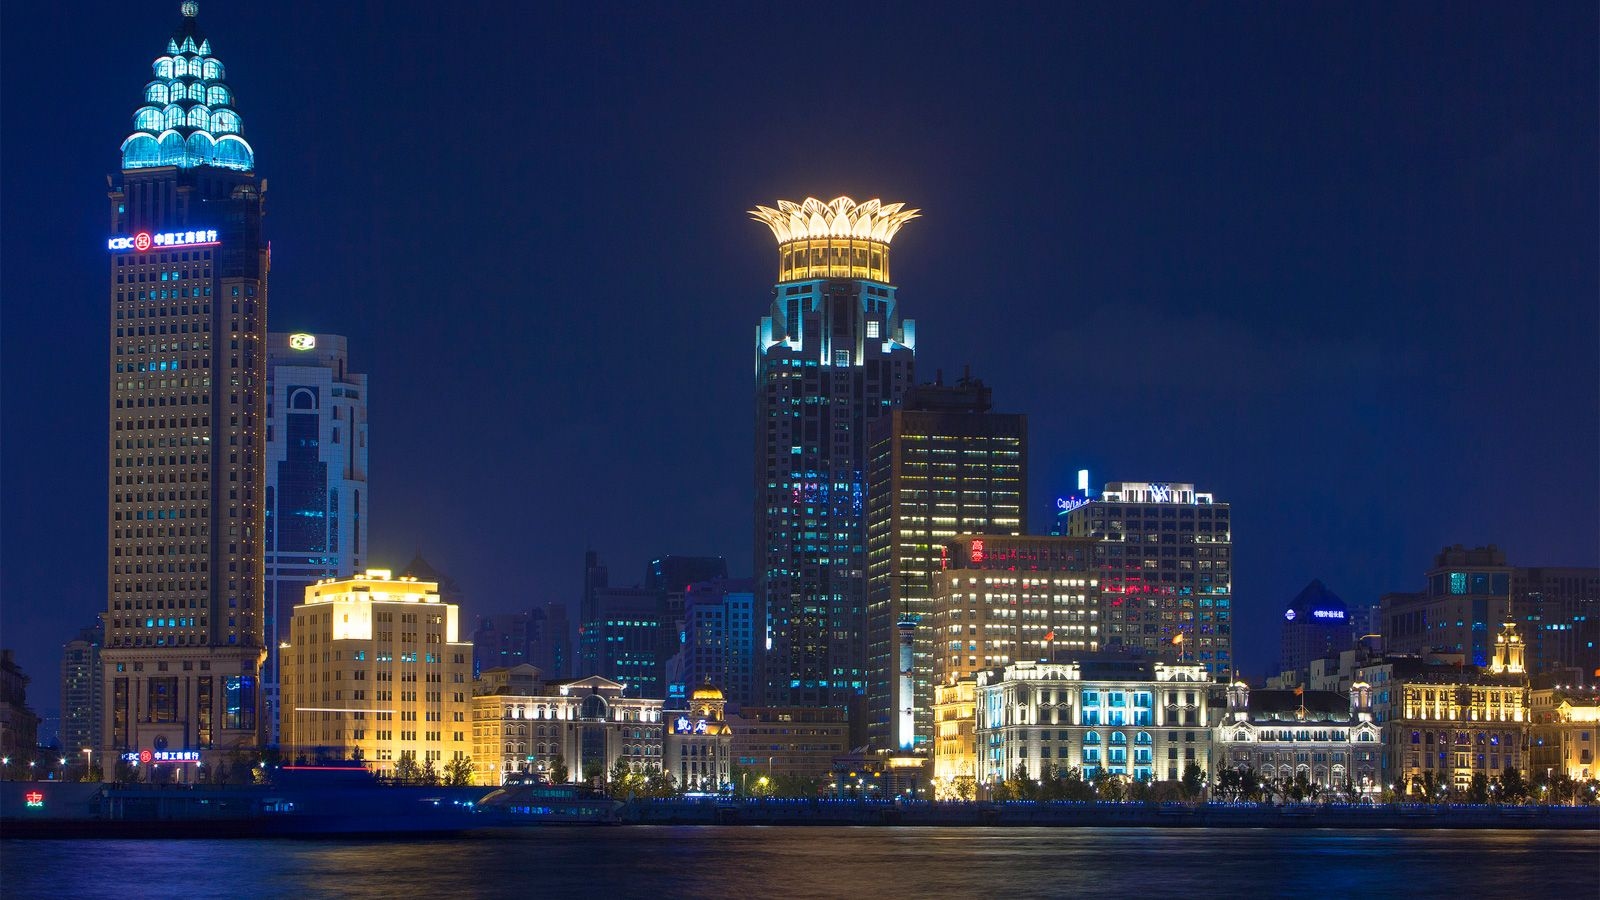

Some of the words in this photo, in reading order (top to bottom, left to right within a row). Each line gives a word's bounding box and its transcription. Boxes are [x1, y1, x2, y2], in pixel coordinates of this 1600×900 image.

[108, 237, 134, 250] ICBC
[153, 229, 217, 246] 中国工商银行
[154, 751, 199, 761] 中国工商银行
